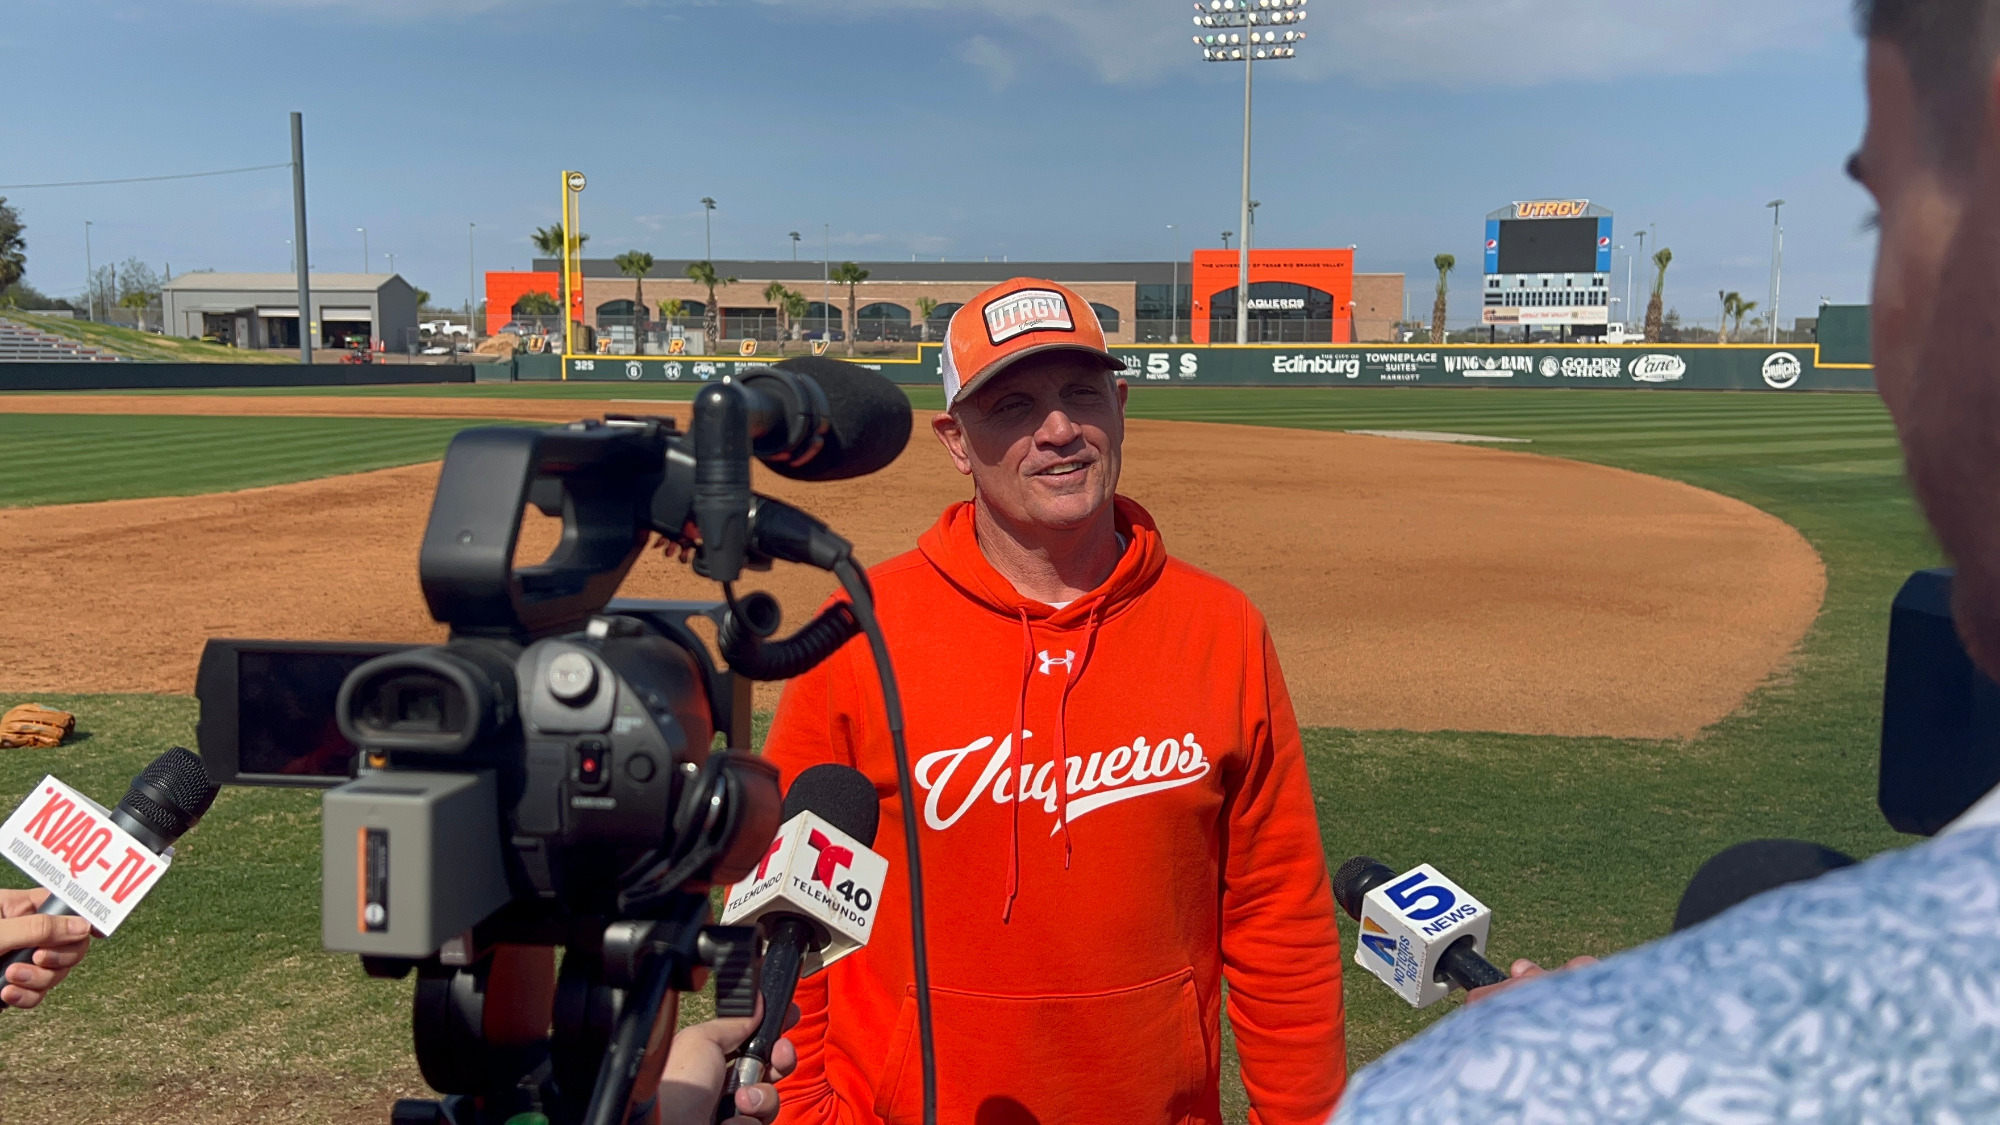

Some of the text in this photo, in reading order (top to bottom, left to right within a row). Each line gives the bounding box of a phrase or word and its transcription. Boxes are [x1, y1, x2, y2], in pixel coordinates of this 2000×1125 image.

[1516, 200, 1588, 218] UTRGV
[991, 298, 1061, 332] UTRGV
[1247, 299, 1305, 309] AQUEROS
[596, 337, 613, 354] T
[668, 338, 685, 355] R
[739, 338, 757, 356] G
[811, 339, 829, 357] V
[1366, 353, 1438, 363] TOWNEPLACE
[574, 360, 595, 371] 325
[666, 367, 679, 378] 44
[1146, 353, 1170, 374] 5
[1179, 352, 1198, 374] S
[1272, 354, 1360, 378] Edinburg
[1385, 363, 1417, 372] SUITES
[1444, 356, 1534, 373] WING BARN
[1562, 357, 1621, 368] GOLDEN
[915, 729, 1210, 837] Vaqueros
[24, 788, 157, 904] KVAQ-TV
[8, 837, 33, 861] YOUR
[28, 853, 66, 889] CAMPUS.
[63, 879, 89, 905] YOUR
[728, 872, 783, 912] TELEMUNDO
[793, 876, 866, 927] TELEMUNDO
[836, 879, 873, 911] 40
[1384, 871, 1456, 921] 5
[1421, 904, 1478, 936] NEWS
[1393, 935, 1411, 987] NOTICIAS
[1405, 953, 1419, 982] RGV
